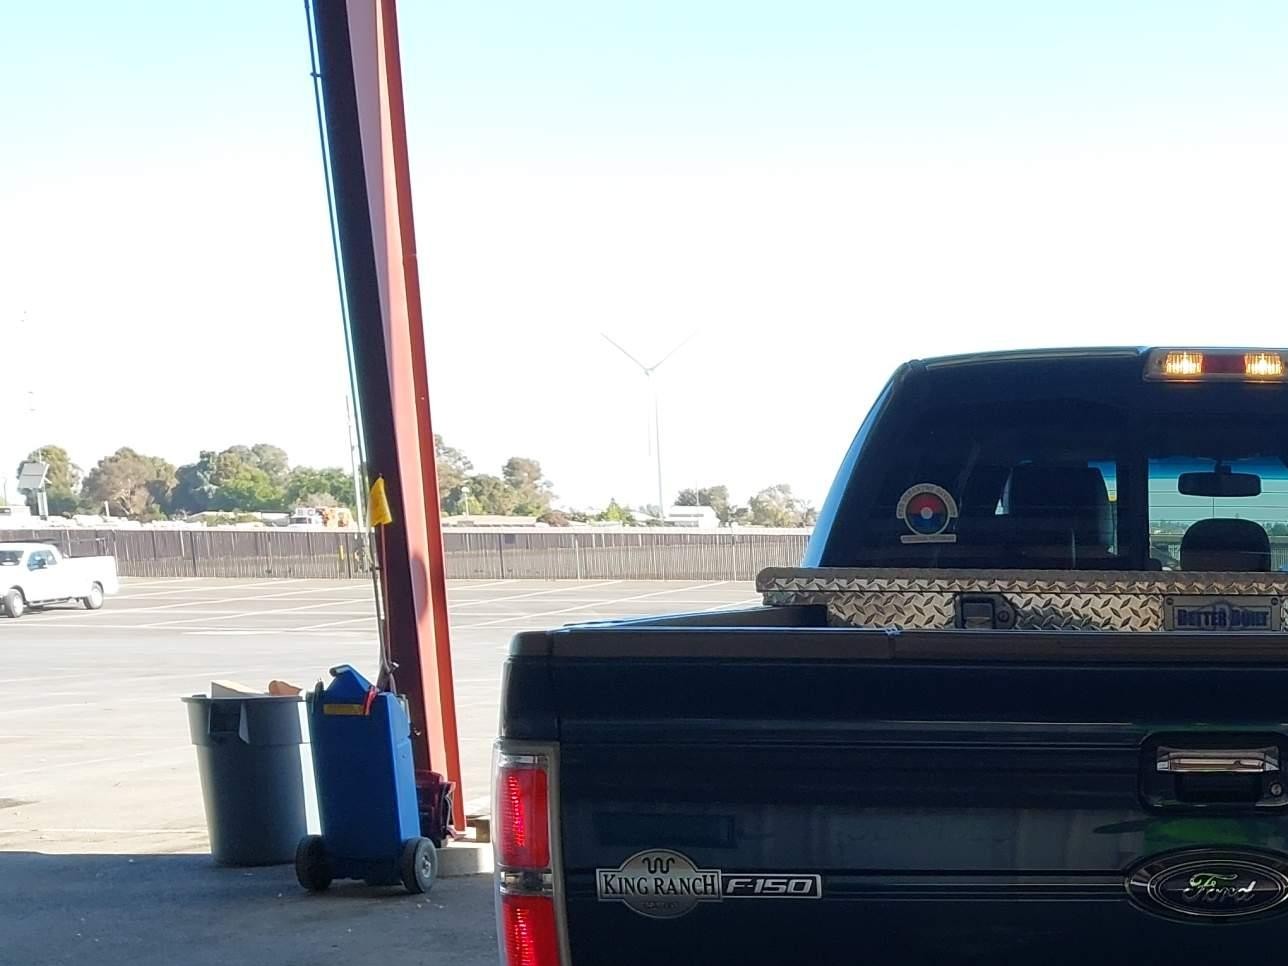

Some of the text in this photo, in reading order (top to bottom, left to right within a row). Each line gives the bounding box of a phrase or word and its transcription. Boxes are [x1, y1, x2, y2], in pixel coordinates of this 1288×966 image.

[603, 873, 813, 896] KING RANCH F-150
[1183, 872, 1257, 902] Ford
